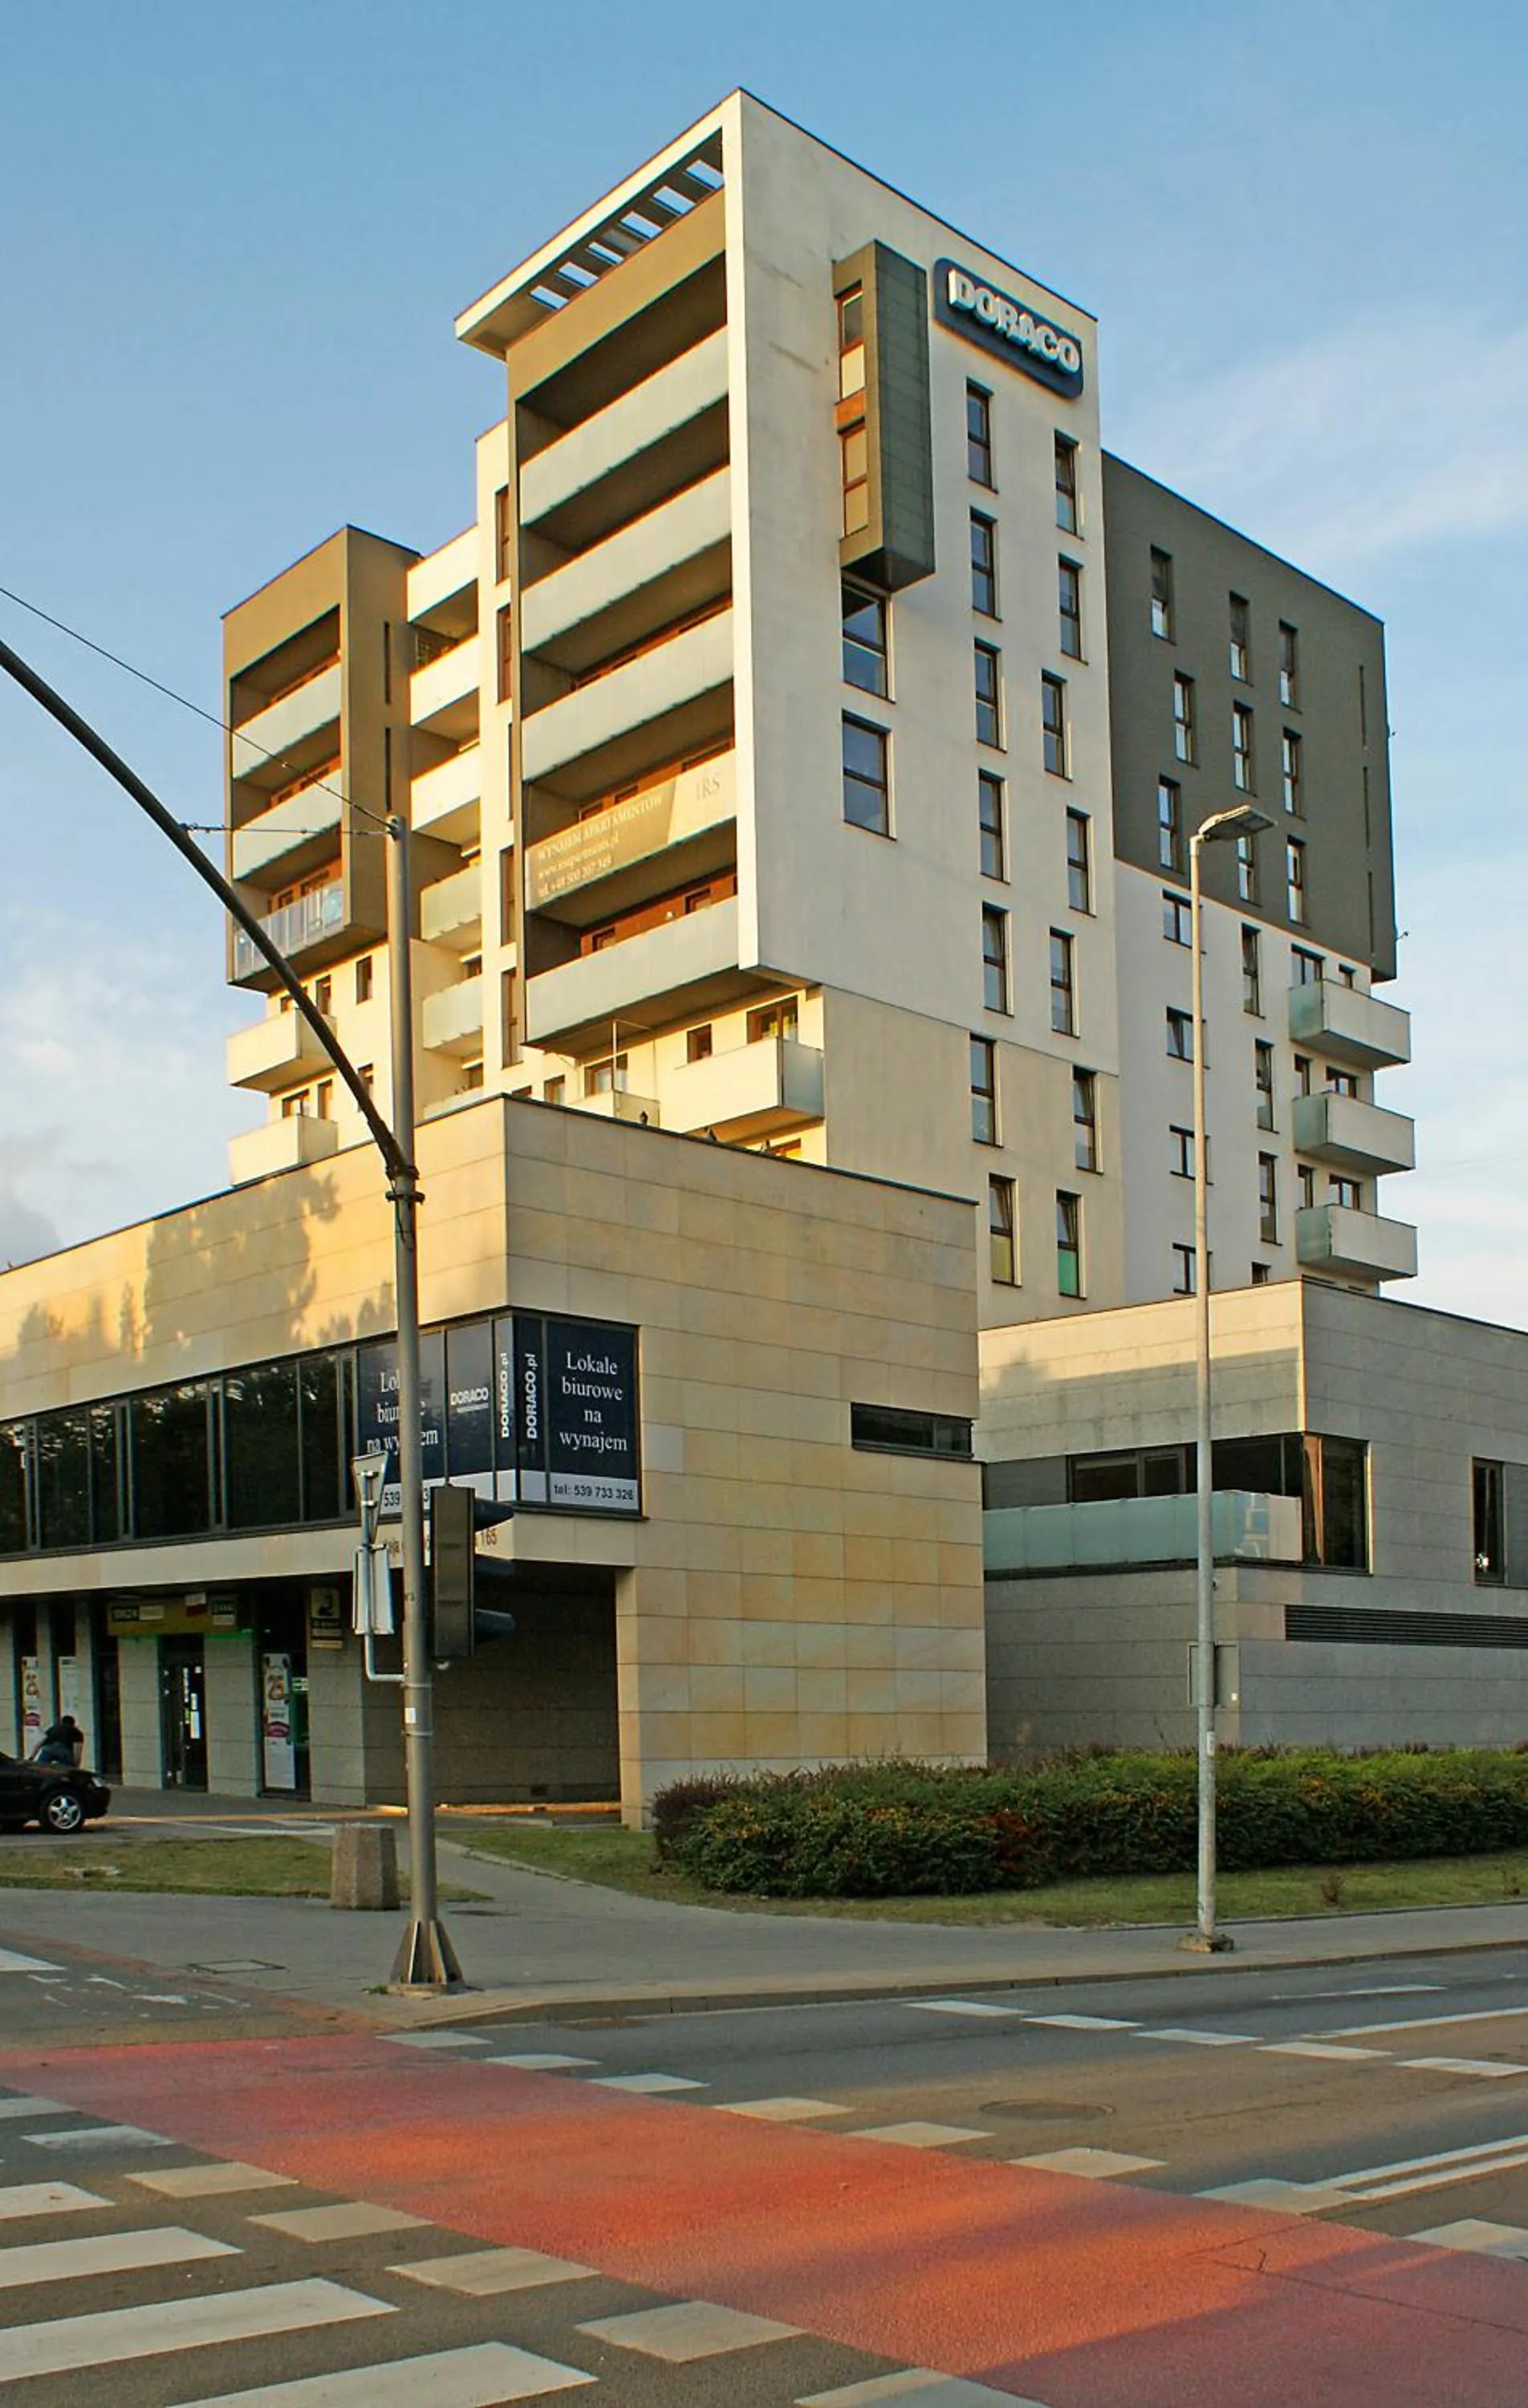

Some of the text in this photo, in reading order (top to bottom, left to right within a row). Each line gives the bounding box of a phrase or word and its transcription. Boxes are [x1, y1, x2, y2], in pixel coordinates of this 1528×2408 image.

[948, 268, 1080, 373] DORACO
[567, 1351, 618, 1375] Lokale
[450, 1387, 489, 1405] DORACO
[525, 1353, 538, 1439] DORACO.pl
[561, 1376, 623, 1401] biurowe
[584, 1409, 602, 1423] na
[385, 1429, 438, 1455] wyem
[559, 1431, 628, 1454] wynajem
[574, 1484, 592, 1497] 539
[595, 1487, 613, 1499] 733
